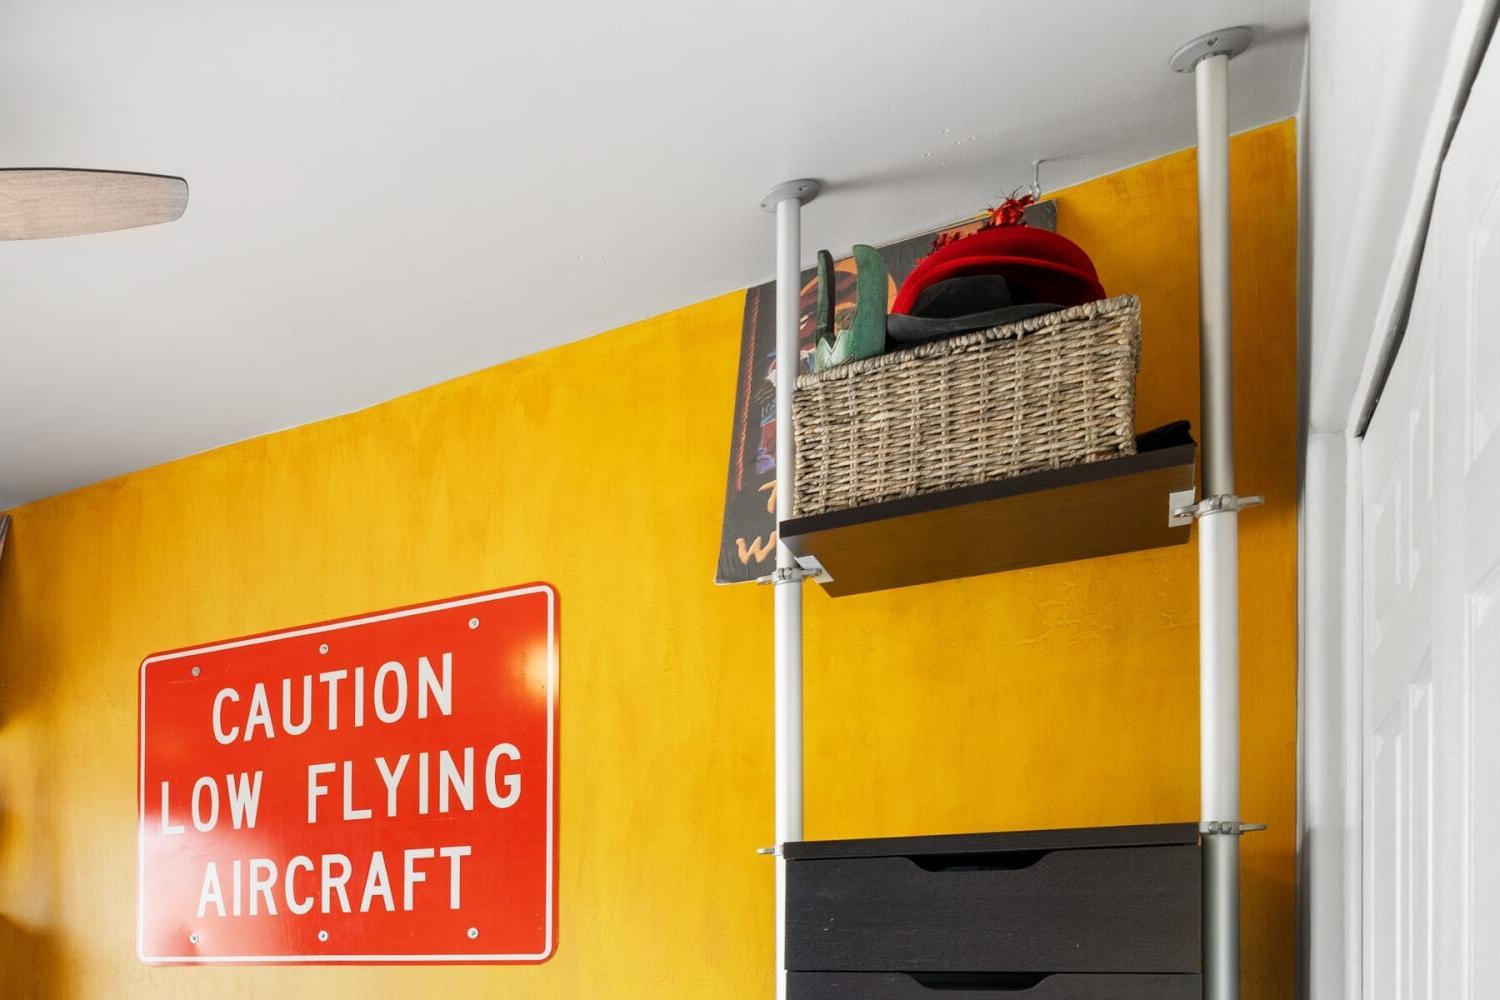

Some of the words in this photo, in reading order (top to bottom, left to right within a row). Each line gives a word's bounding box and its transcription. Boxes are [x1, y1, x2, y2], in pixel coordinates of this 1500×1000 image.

[212, 652, 453, 745] CAUTION
[160, 770, 264, 835] LOW
[307, 742, 522, 824] FLYING
[196, 845, 472, 918] AIRCRAFT
